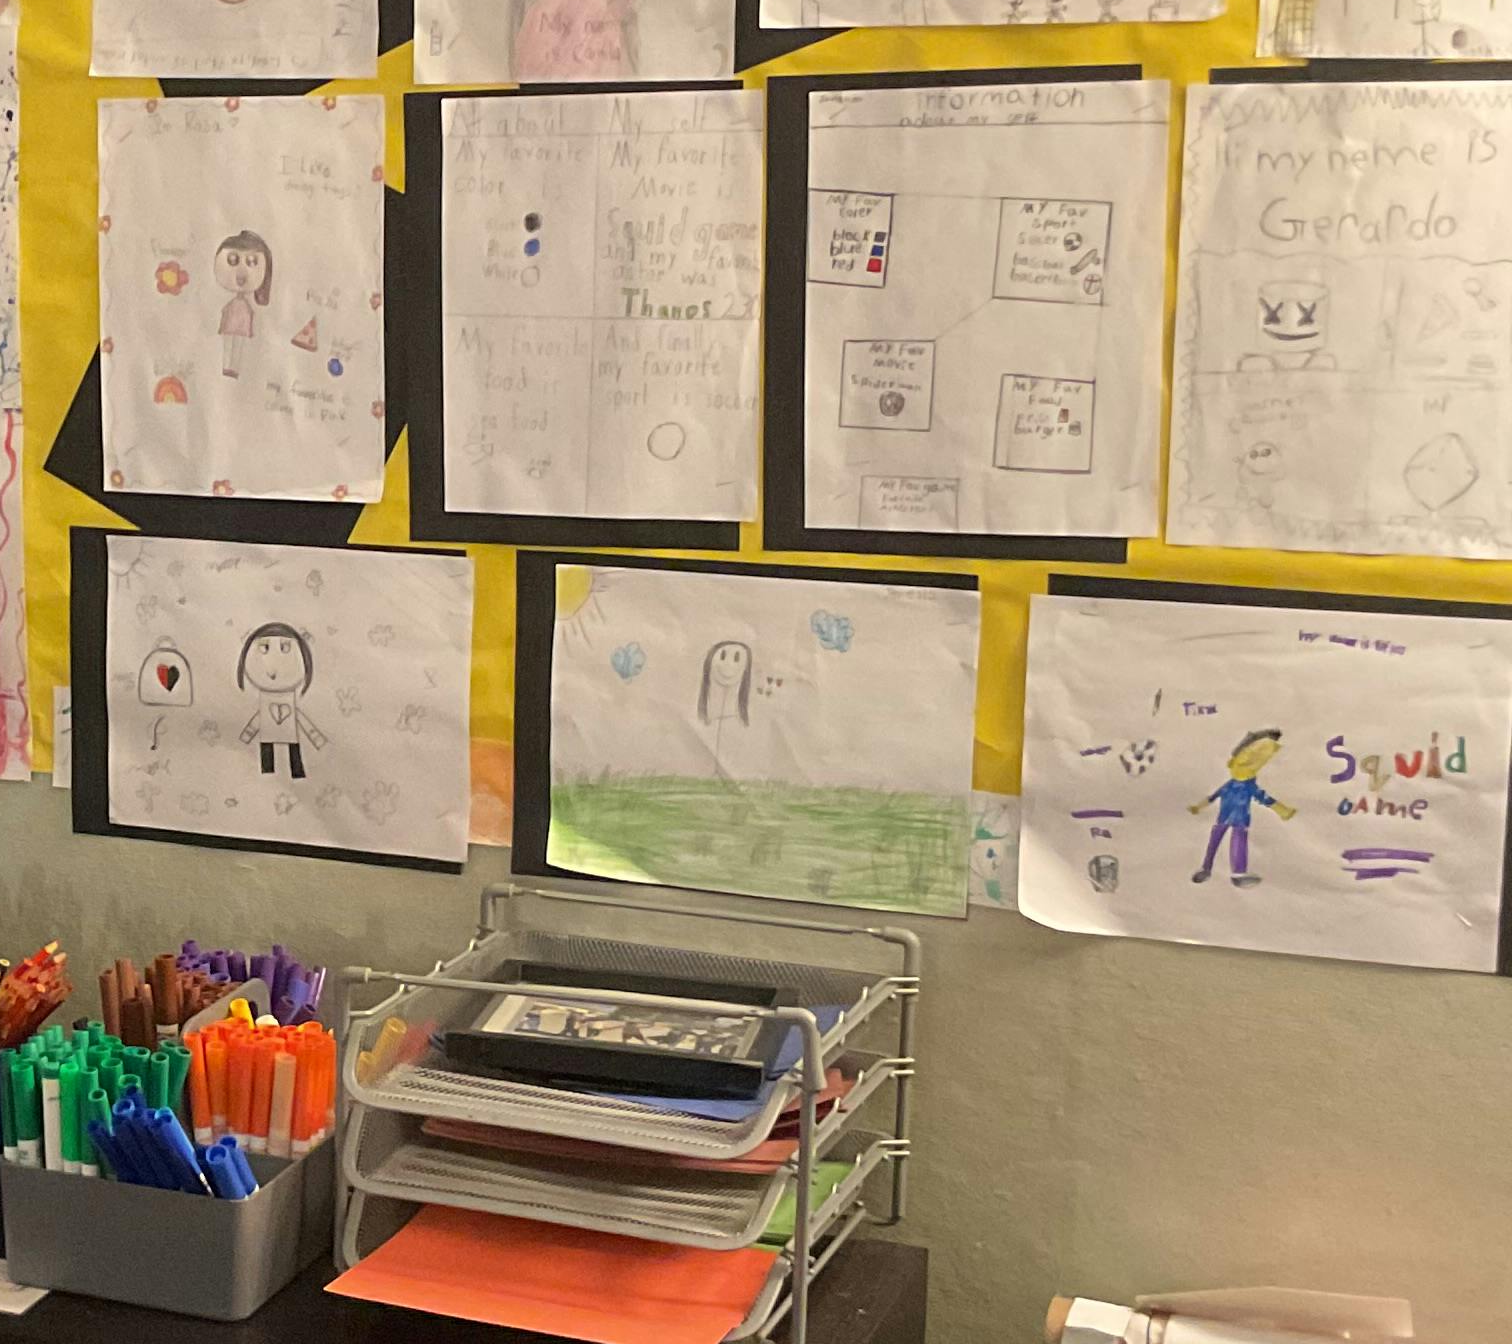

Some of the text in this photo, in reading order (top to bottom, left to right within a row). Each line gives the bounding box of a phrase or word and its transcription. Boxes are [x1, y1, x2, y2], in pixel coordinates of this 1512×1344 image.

[610, 140, 642, 175] My
[1259, 190, 1459, 243] Gerardo
[620, 287, 713, 321] Thanos
[1325, 731, 1468, 793] Squid
